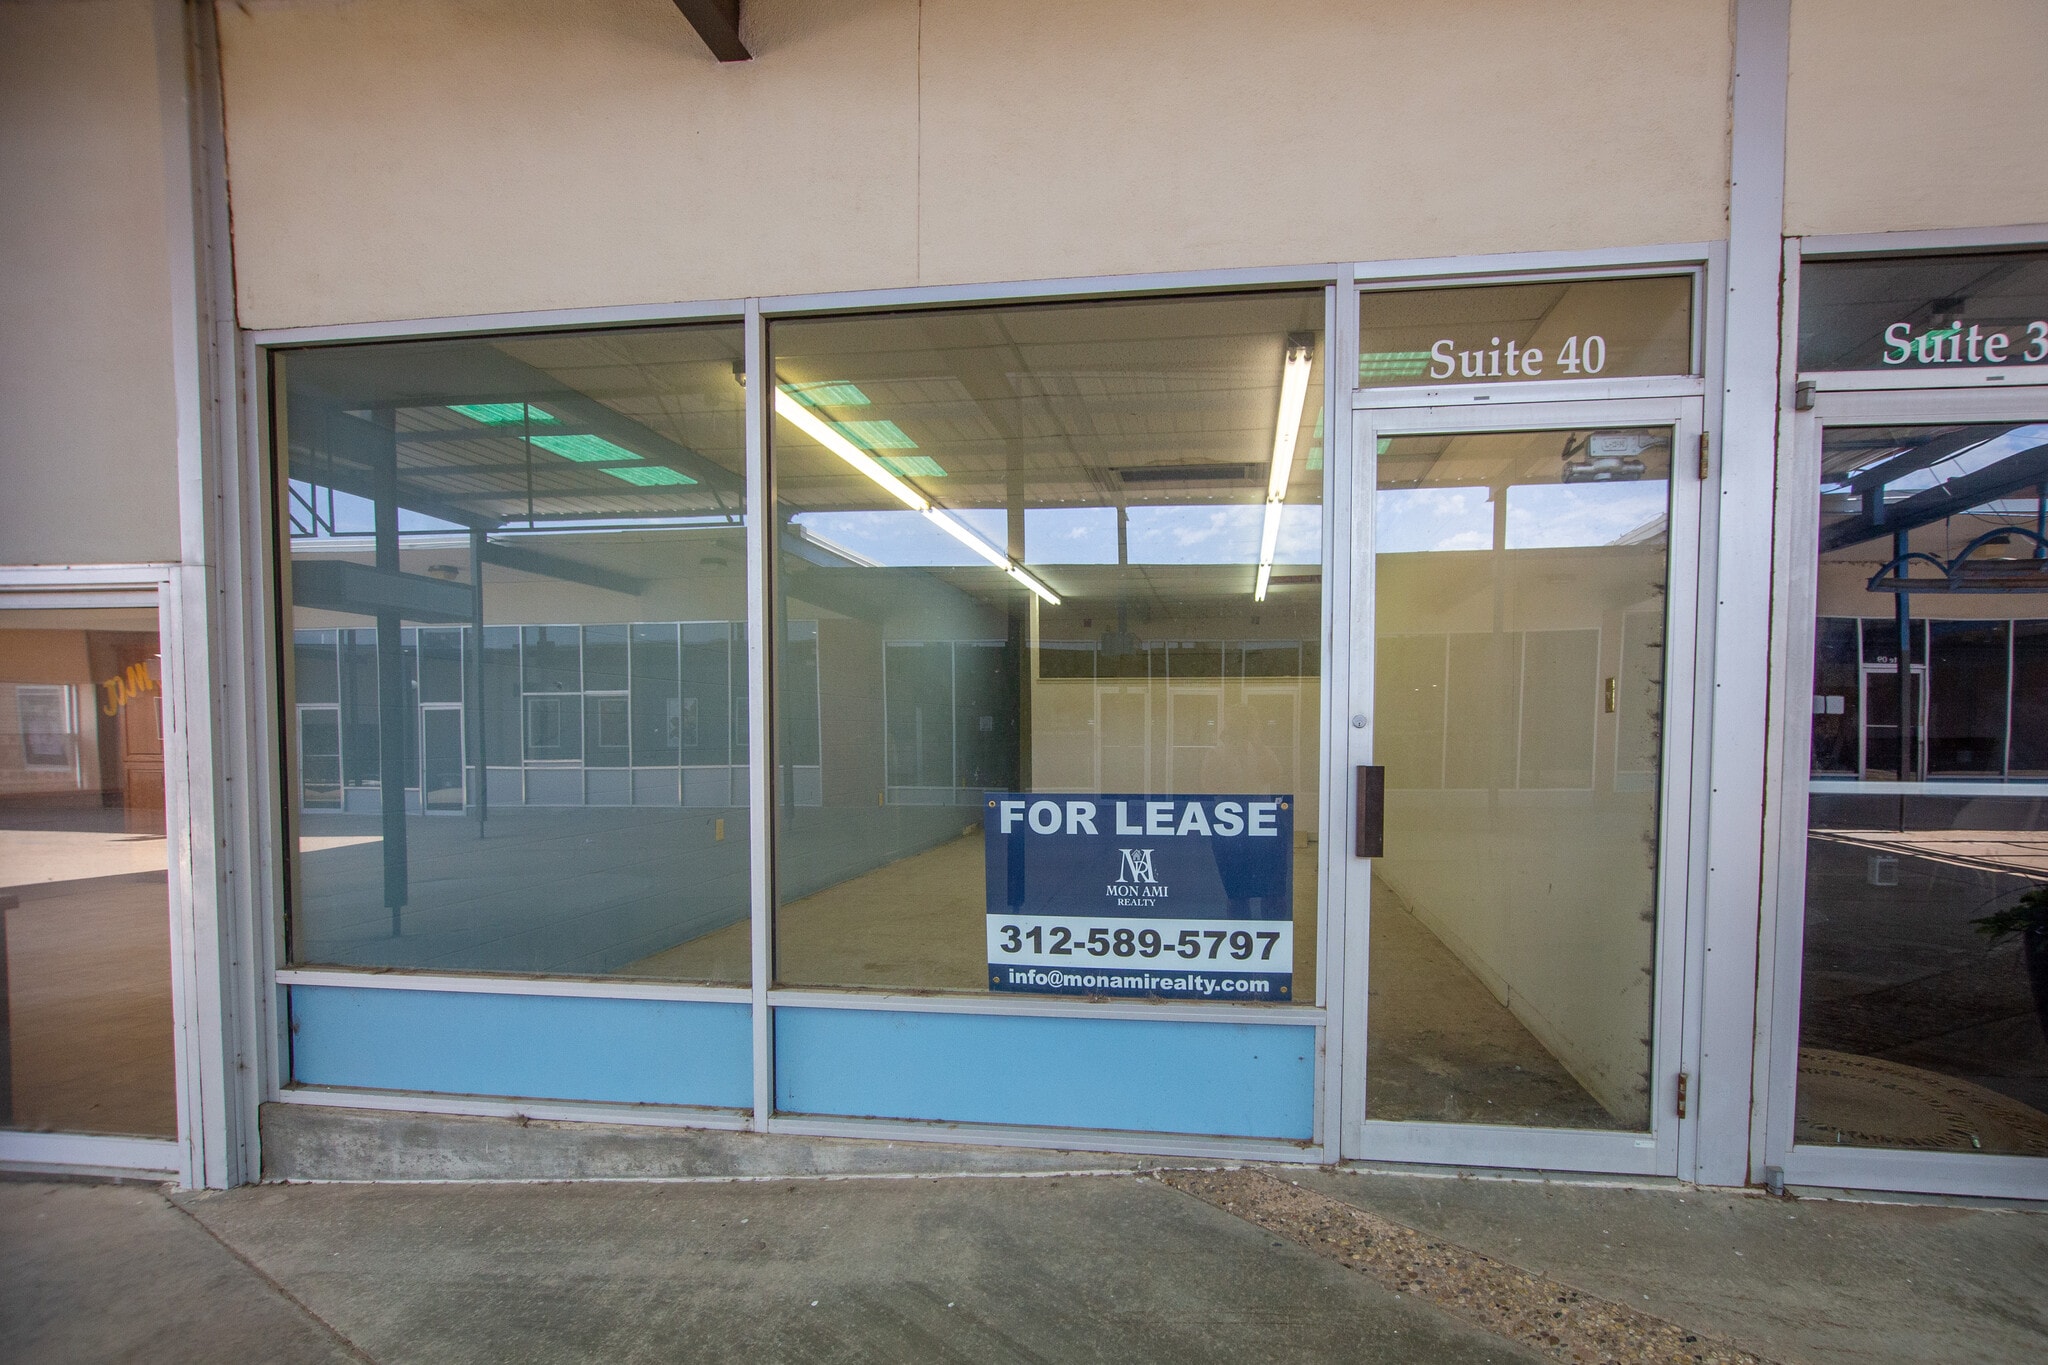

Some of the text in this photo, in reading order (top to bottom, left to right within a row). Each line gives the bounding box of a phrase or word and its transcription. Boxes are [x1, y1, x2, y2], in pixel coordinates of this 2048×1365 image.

[1430, 335, 1606, 380] Suite 40
[1883, 320, 2010, 365] Suite
[1000, 801, 1278, 837] FOR LEASE
[1106, 885, 1169, 897] MON AMI
[1117, 898, 1156, 907] REALTY
[1000, 925, 1280, 961] 312-589-5797
[1008, 968, 1270, 995] info@monamirealty.com
